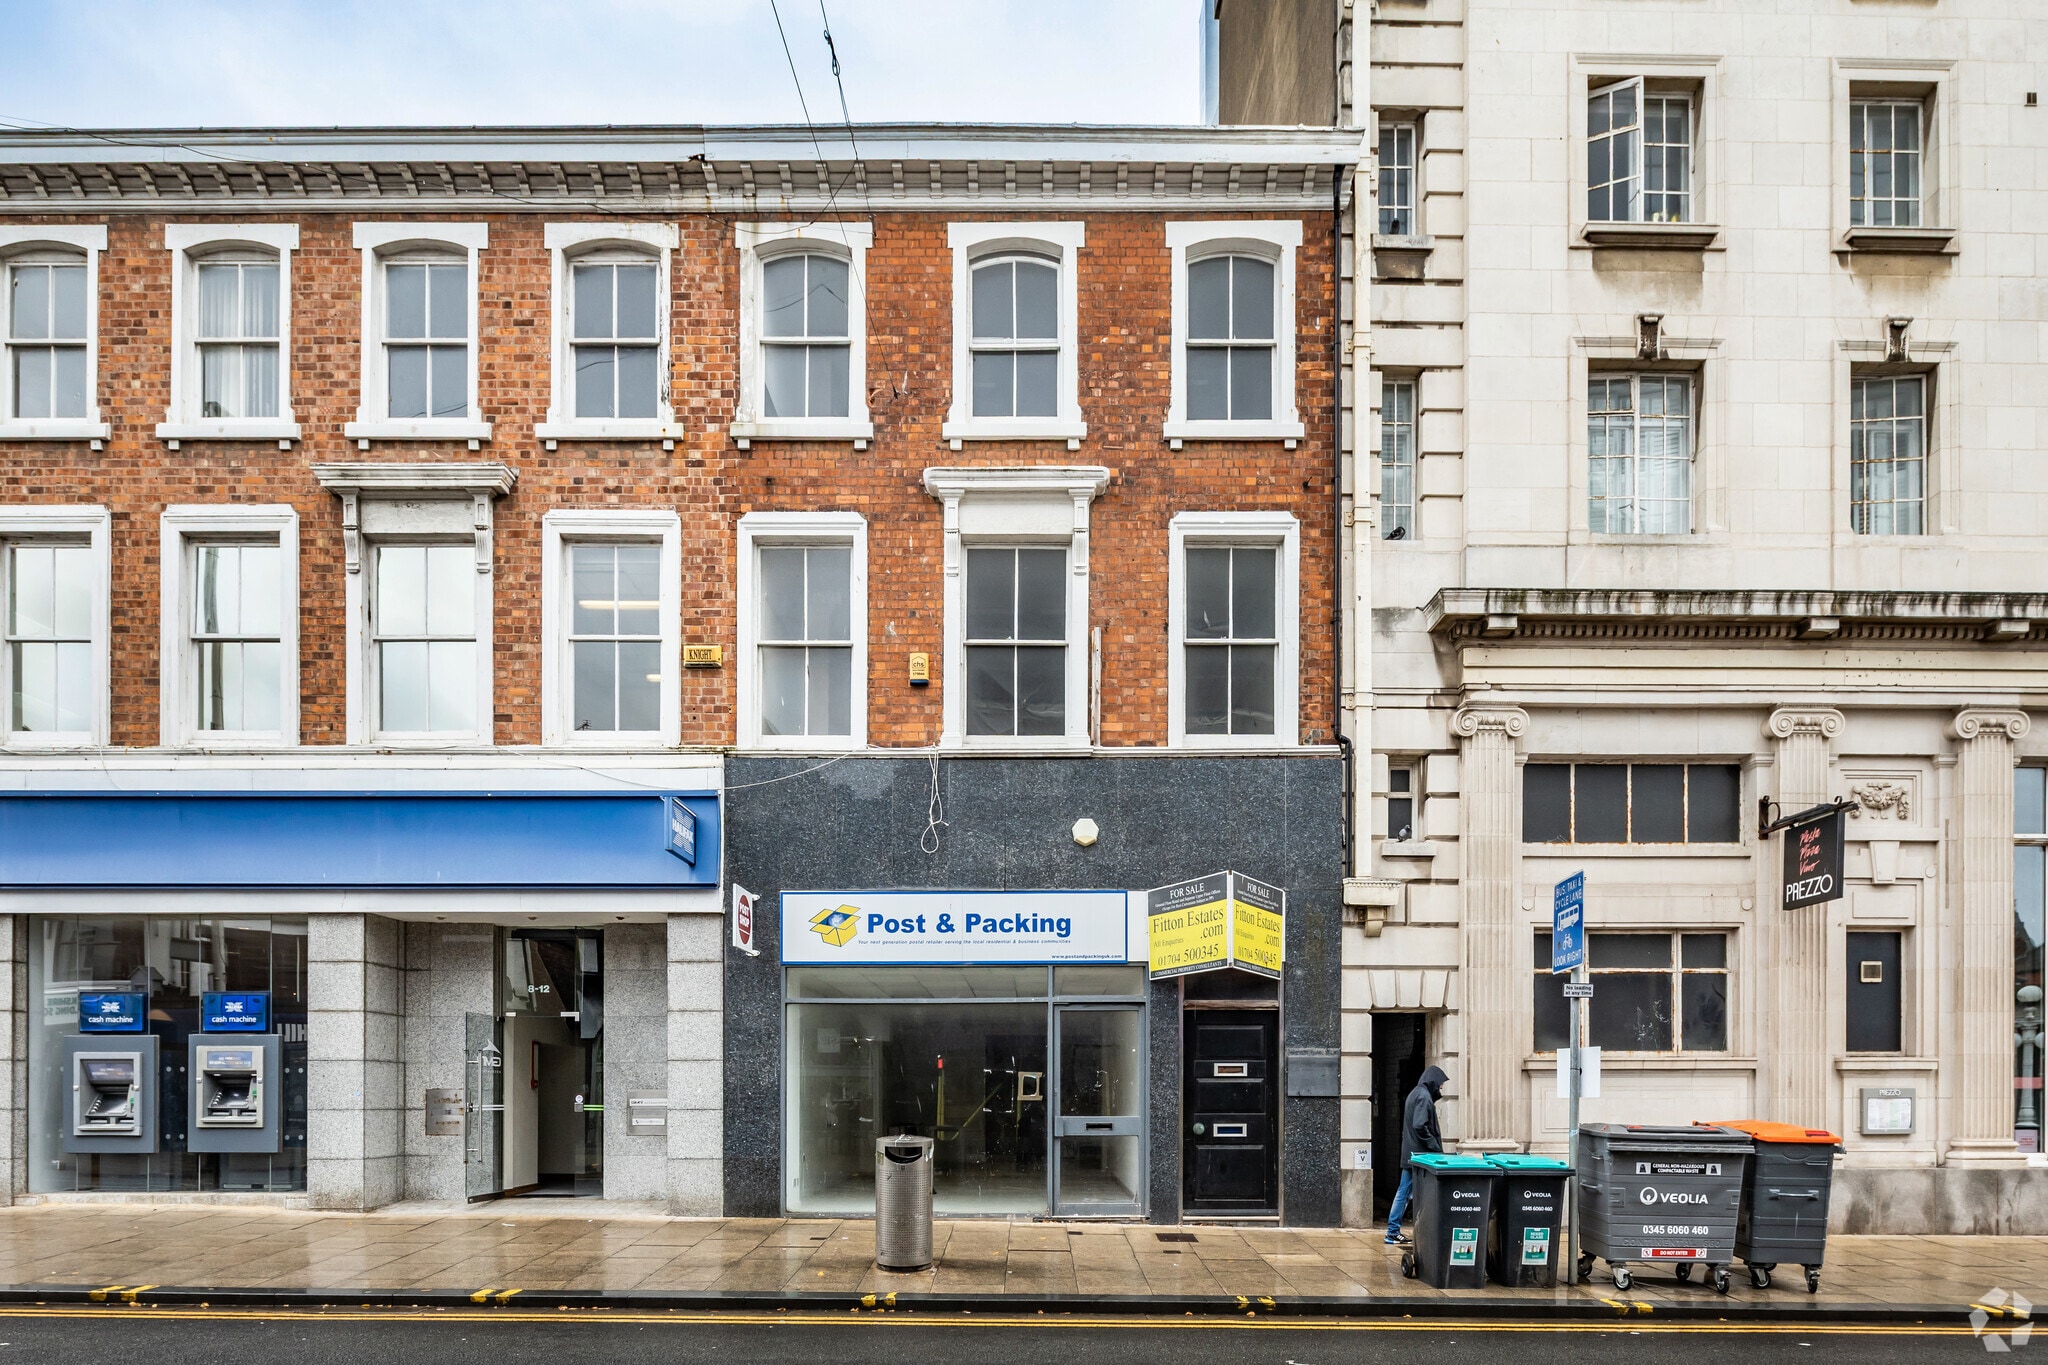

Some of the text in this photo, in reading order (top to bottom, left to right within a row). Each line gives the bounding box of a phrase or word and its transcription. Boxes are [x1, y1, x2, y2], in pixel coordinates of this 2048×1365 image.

[689, 649, 712, 660] KNIGHT
[672, 818, 694, 844] HALIFAX
[1170, 882, 1205, 899] FOR SALE
[1248, 882, 1270, 898] FOR SALE
[1786, 874, 1833, 903] PREZZO
[1555, 888, 1582, 910] CYCLE LANE
[868, 913, 1071, 938] Post & Packing
[1153, 908, 1224, 934] Fitton Estates
[1236, 904, 1280, 933] Fitton Estates
[1200, 924, 1224, 939] .com
[1264, 934, 1280, 948] .com
[1158, 944, 1219, 966] 01704 500345
[1555, 955, 1566, 968] LOOK
[528, 985, 550, 993] 8-12
[1660, 1193, 1708, 1204] VEOLIA
[1642, 1225, 1709, 1235] 0345 6060 460
